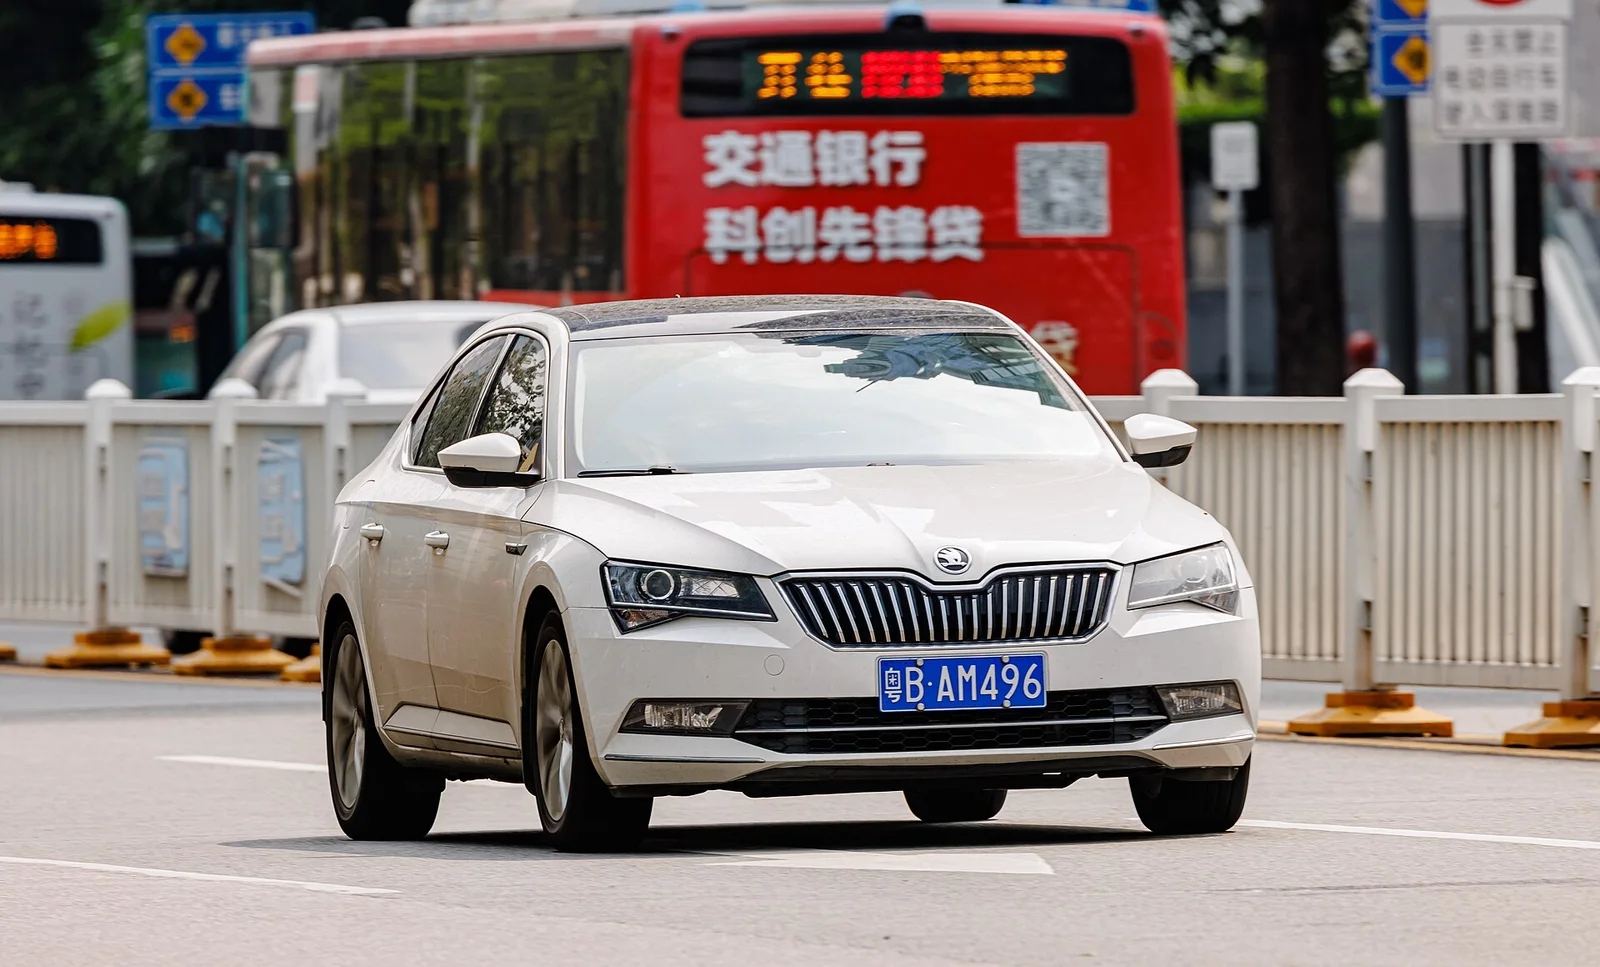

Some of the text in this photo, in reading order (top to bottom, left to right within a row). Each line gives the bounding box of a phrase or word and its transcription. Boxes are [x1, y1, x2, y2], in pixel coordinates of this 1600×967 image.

[702, 130, 926, 187] 交通银行
[703, 205, 984, 264] 科创先锋贷
[884, 663, 1043, 704] 粤B·AM496
